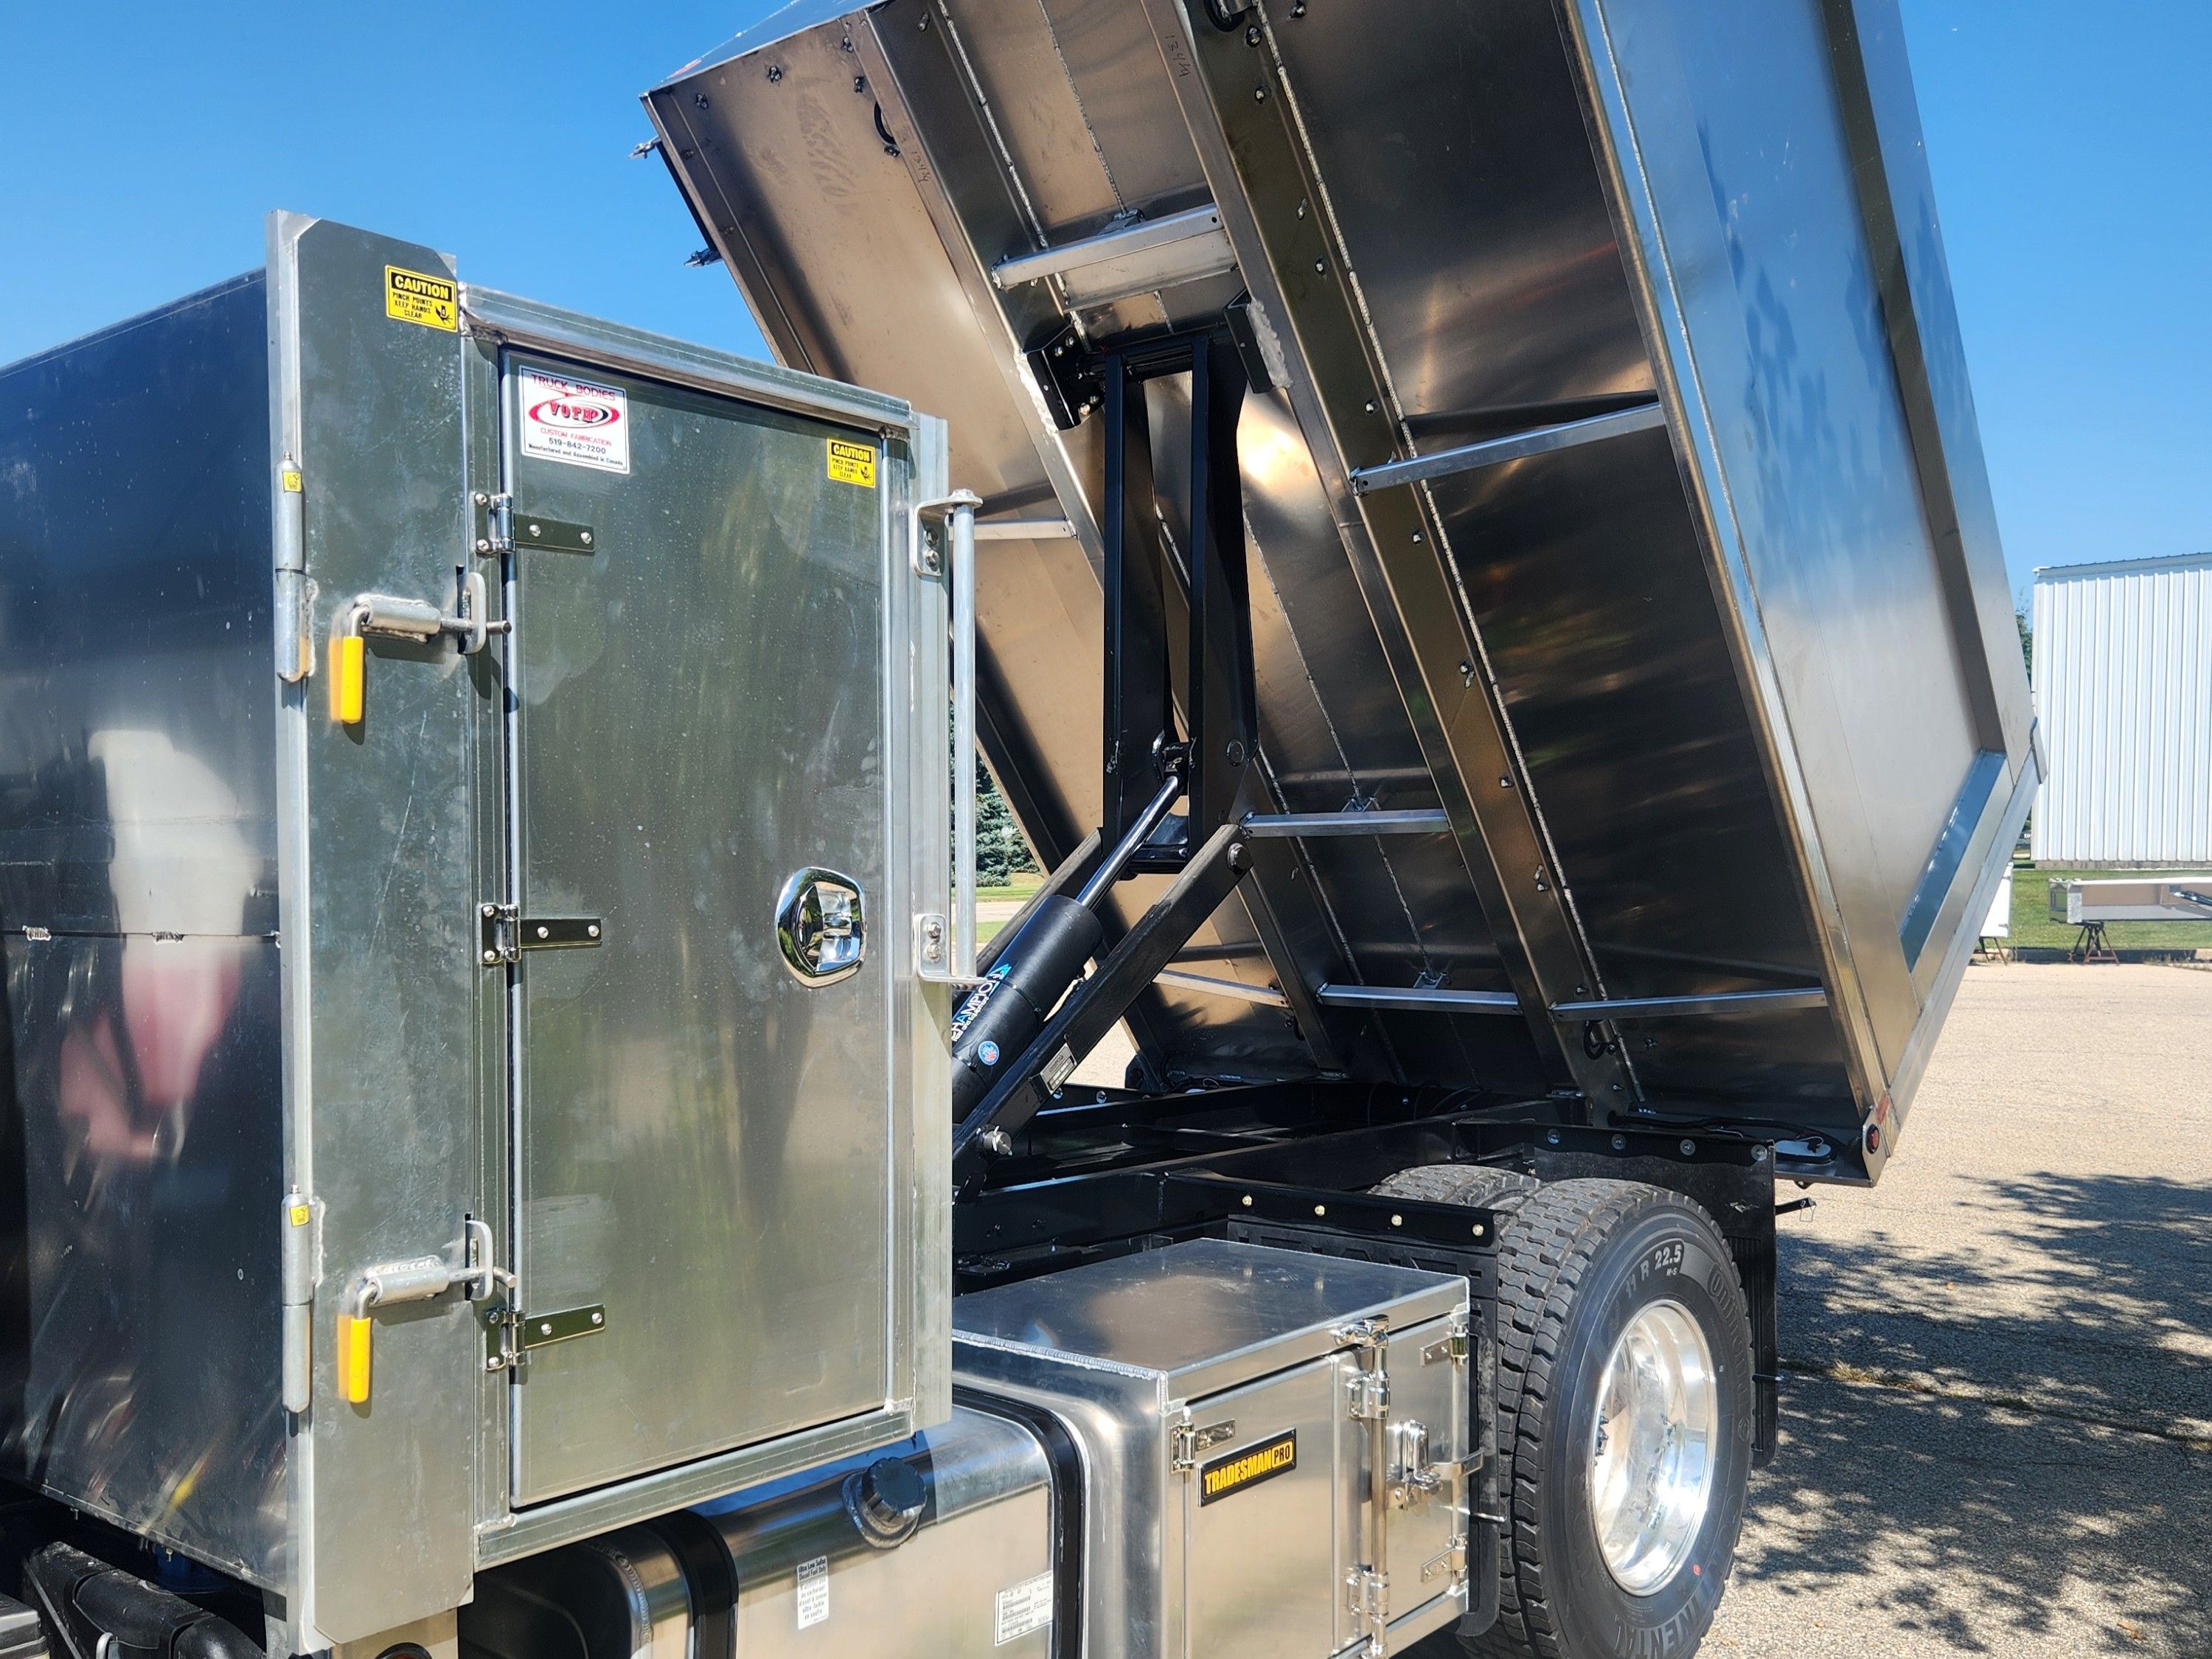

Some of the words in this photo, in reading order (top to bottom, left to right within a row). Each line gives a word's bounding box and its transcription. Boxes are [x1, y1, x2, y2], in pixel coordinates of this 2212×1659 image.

[394, 275, 449, 299] CAUTION
[392, 291, 410, 302] PINCH
[412, 296, 433, 307] POINTS
[394, 300, 409, 309] KEEP
[411, 304, 431, 314] HANDS
[404, 310, 422, 319] CLEAR
[531, 374, 568, 392] TRUCK
[575, 383, 616, 401] BODIES
[549, 400, 596, 423] VOTH
[540, 427, 568, 438] CUSTOM
[571, 433, 613, 446] FABRICATION
[549, 437, 607, 454] 519-842-7200
[833, 444, 870, 462] CAUTION
[1641, 1259, 1649, 1281] R
[1655, 1244, 1682, 1270] 22.5
[1205, 1448, 1273, 1495] TRADESMAN
[1274, 1444, 1290, 1466] PRO
